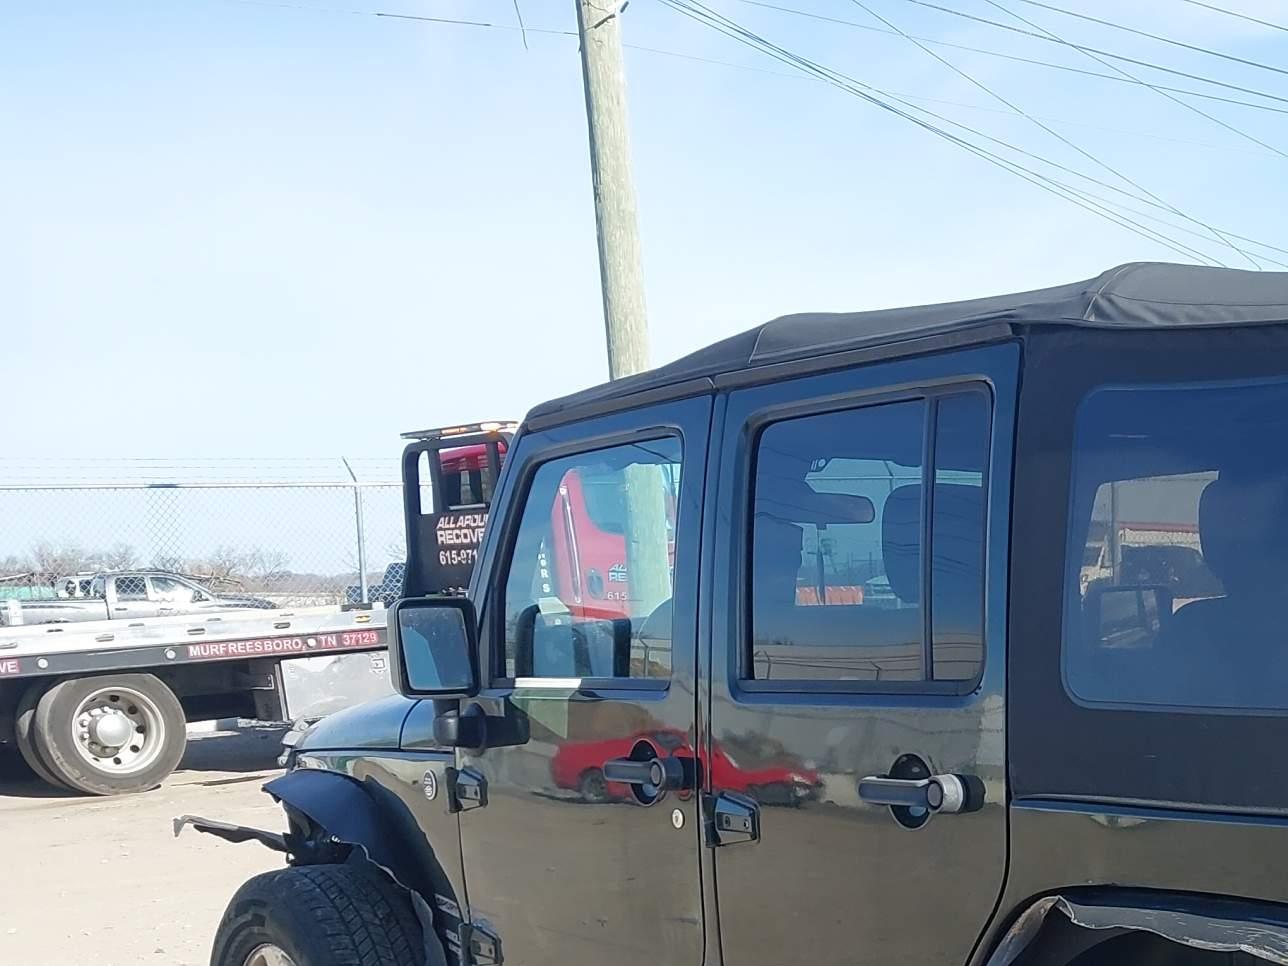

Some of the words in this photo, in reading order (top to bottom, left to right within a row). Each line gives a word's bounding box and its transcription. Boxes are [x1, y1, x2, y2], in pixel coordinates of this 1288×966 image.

[436, 516, 456, 529] ALL
[440, 549, 477, 565] 615-971
[189, 638, 307, 657] MURFREESBORO,
[320, 634, 336, 648] TN
[343, 631, 377, 646] 37129
